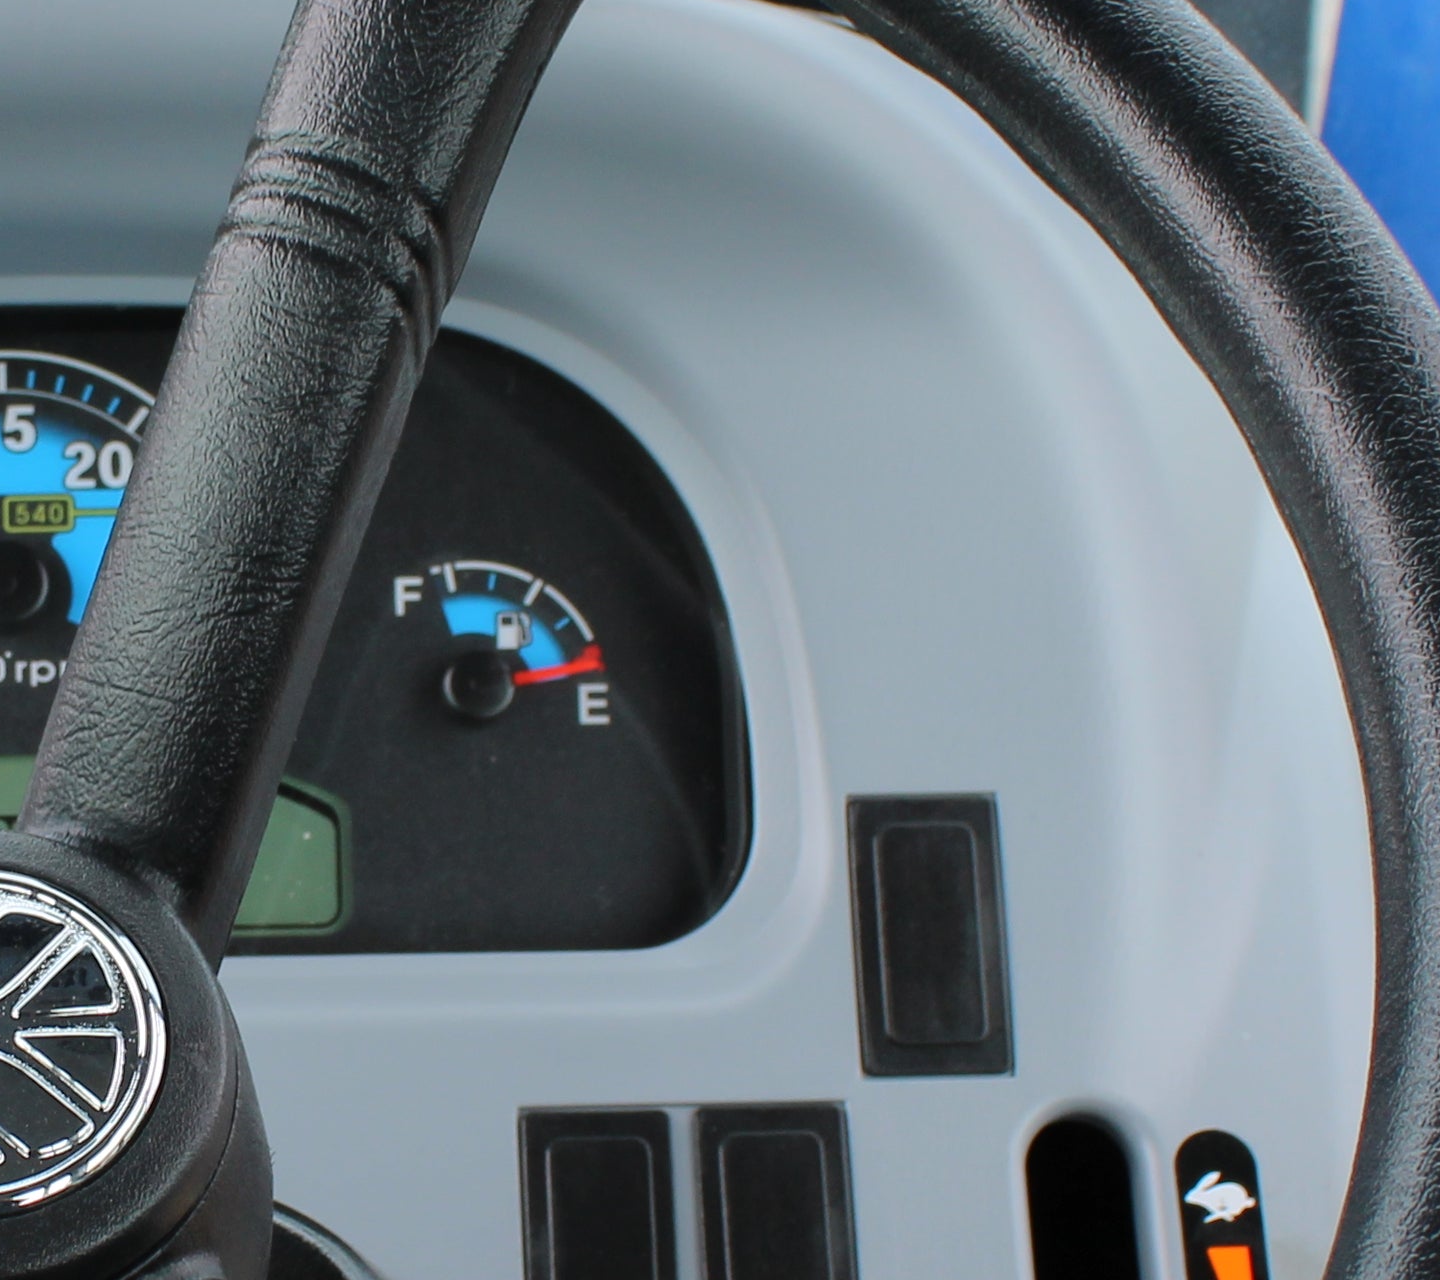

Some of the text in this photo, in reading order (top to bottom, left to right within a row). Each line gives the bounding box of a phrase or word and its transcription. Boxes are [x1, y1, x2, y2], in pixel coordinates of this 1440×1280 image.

[64, 440, 133, 490] 20
[13, 502, 65, 525] 540
[393, 576, 424, 617] F
[14, 658, 68, 689] rp
[577, 682, 610, 725] E
